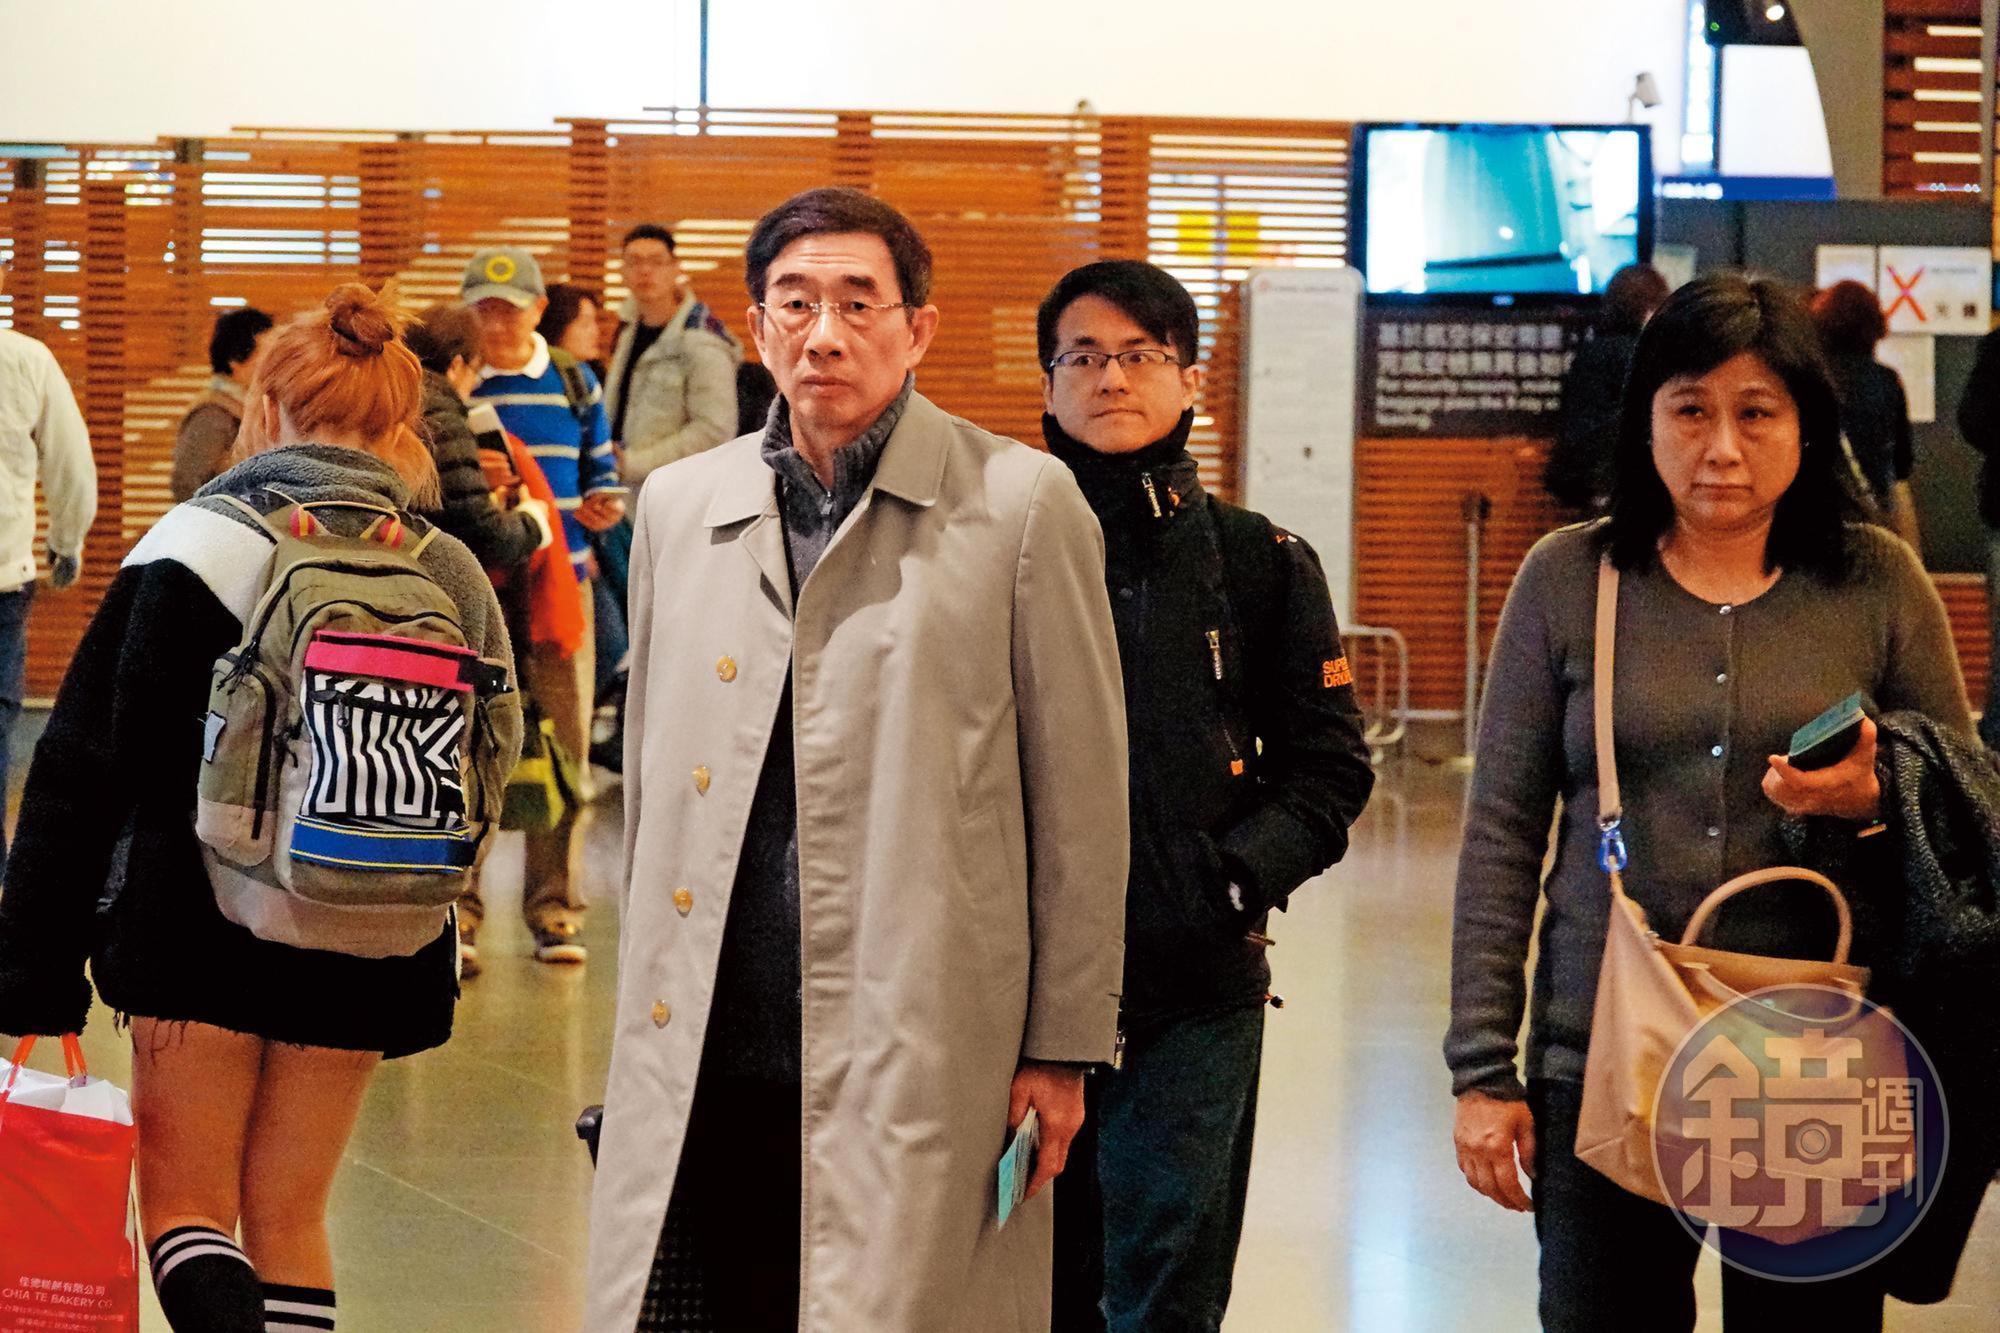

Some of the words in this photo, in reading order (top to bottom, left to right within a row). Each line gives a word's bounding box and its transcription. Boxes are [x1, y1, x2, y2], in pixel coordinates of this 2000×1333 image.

[2, 1288, 30, 1300] CHIA
[35, 1291, 48, 1302] TE
[51, 1294, 96, 1308] BAKERY
